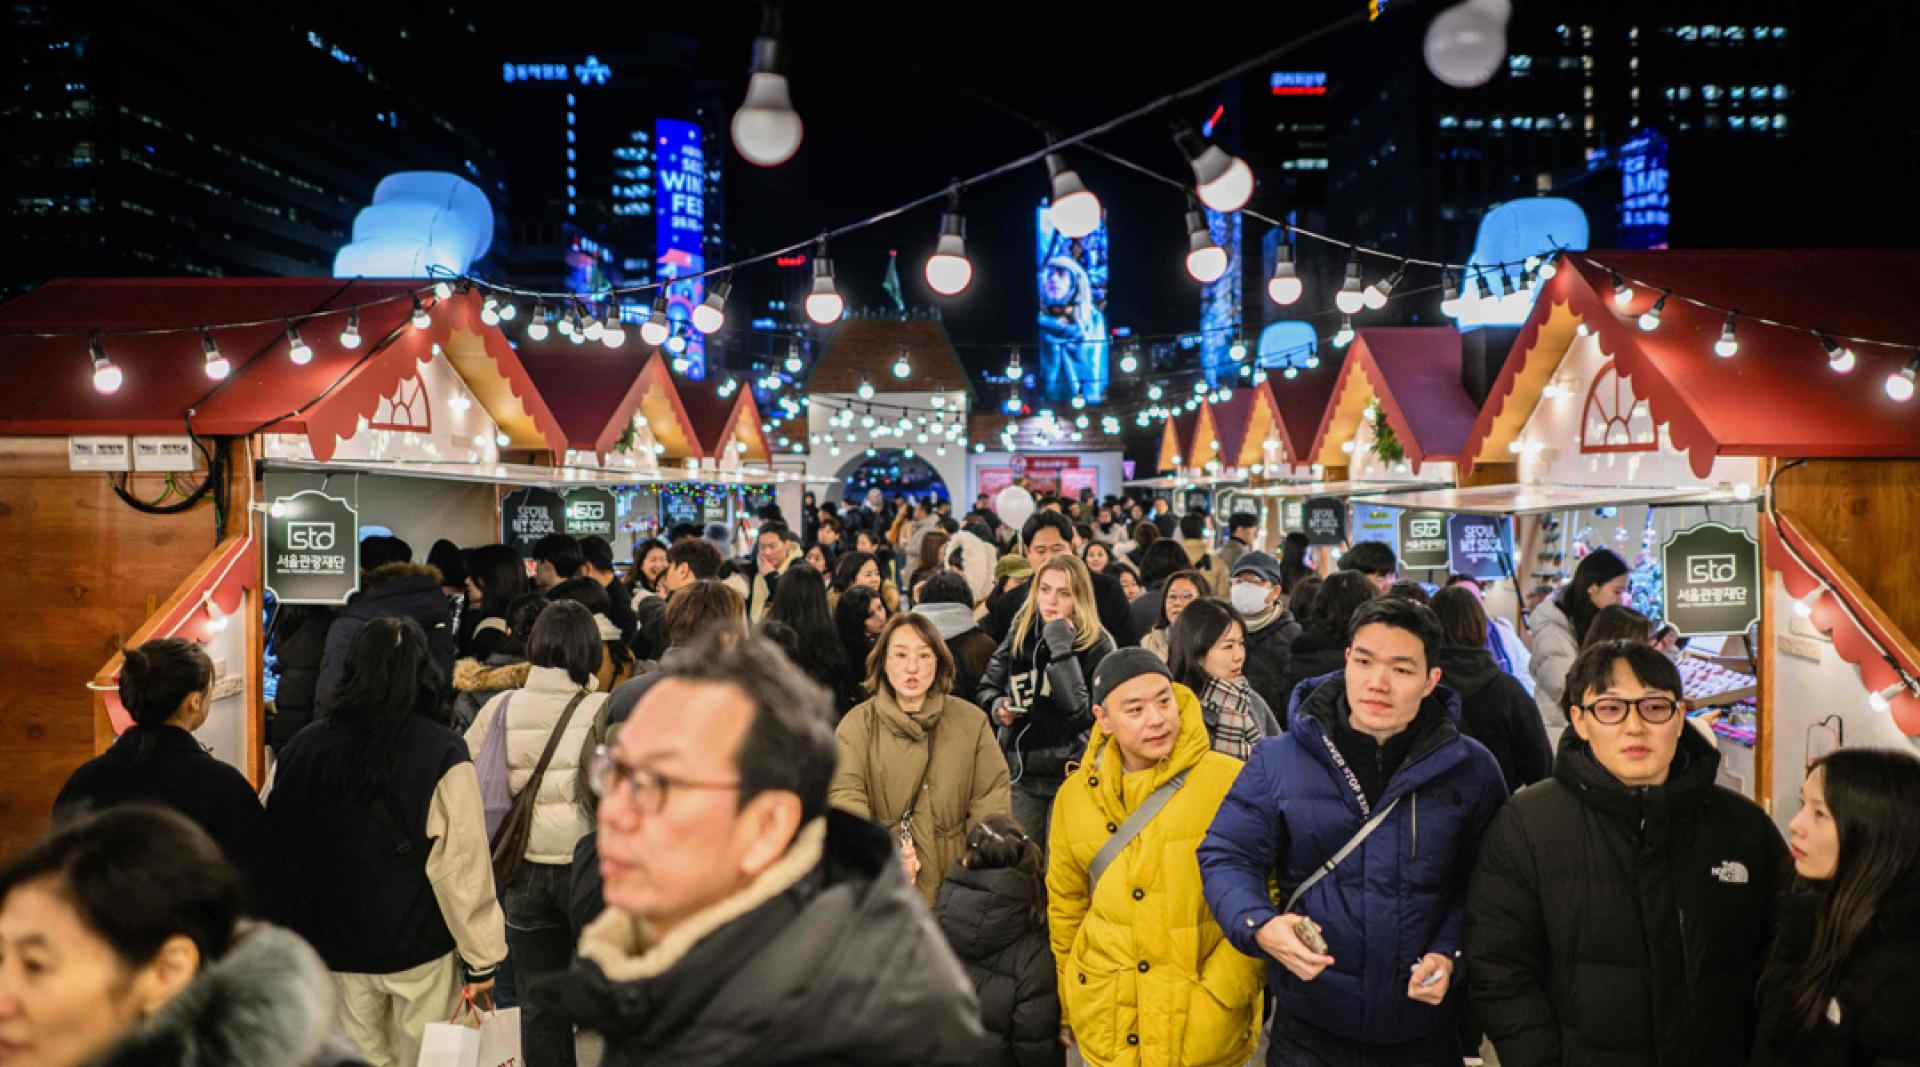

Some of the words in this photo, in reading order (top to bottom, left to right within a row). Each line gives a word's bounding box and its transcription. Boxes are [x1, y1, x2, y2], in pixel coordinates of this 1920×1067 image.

[288, 521, 335, 550] std
[276, 554, 345, 569] 서울관광재단
[1687, 554, 1736, 583] std
[1677, 587, 1747, 602] 서울관광재단
